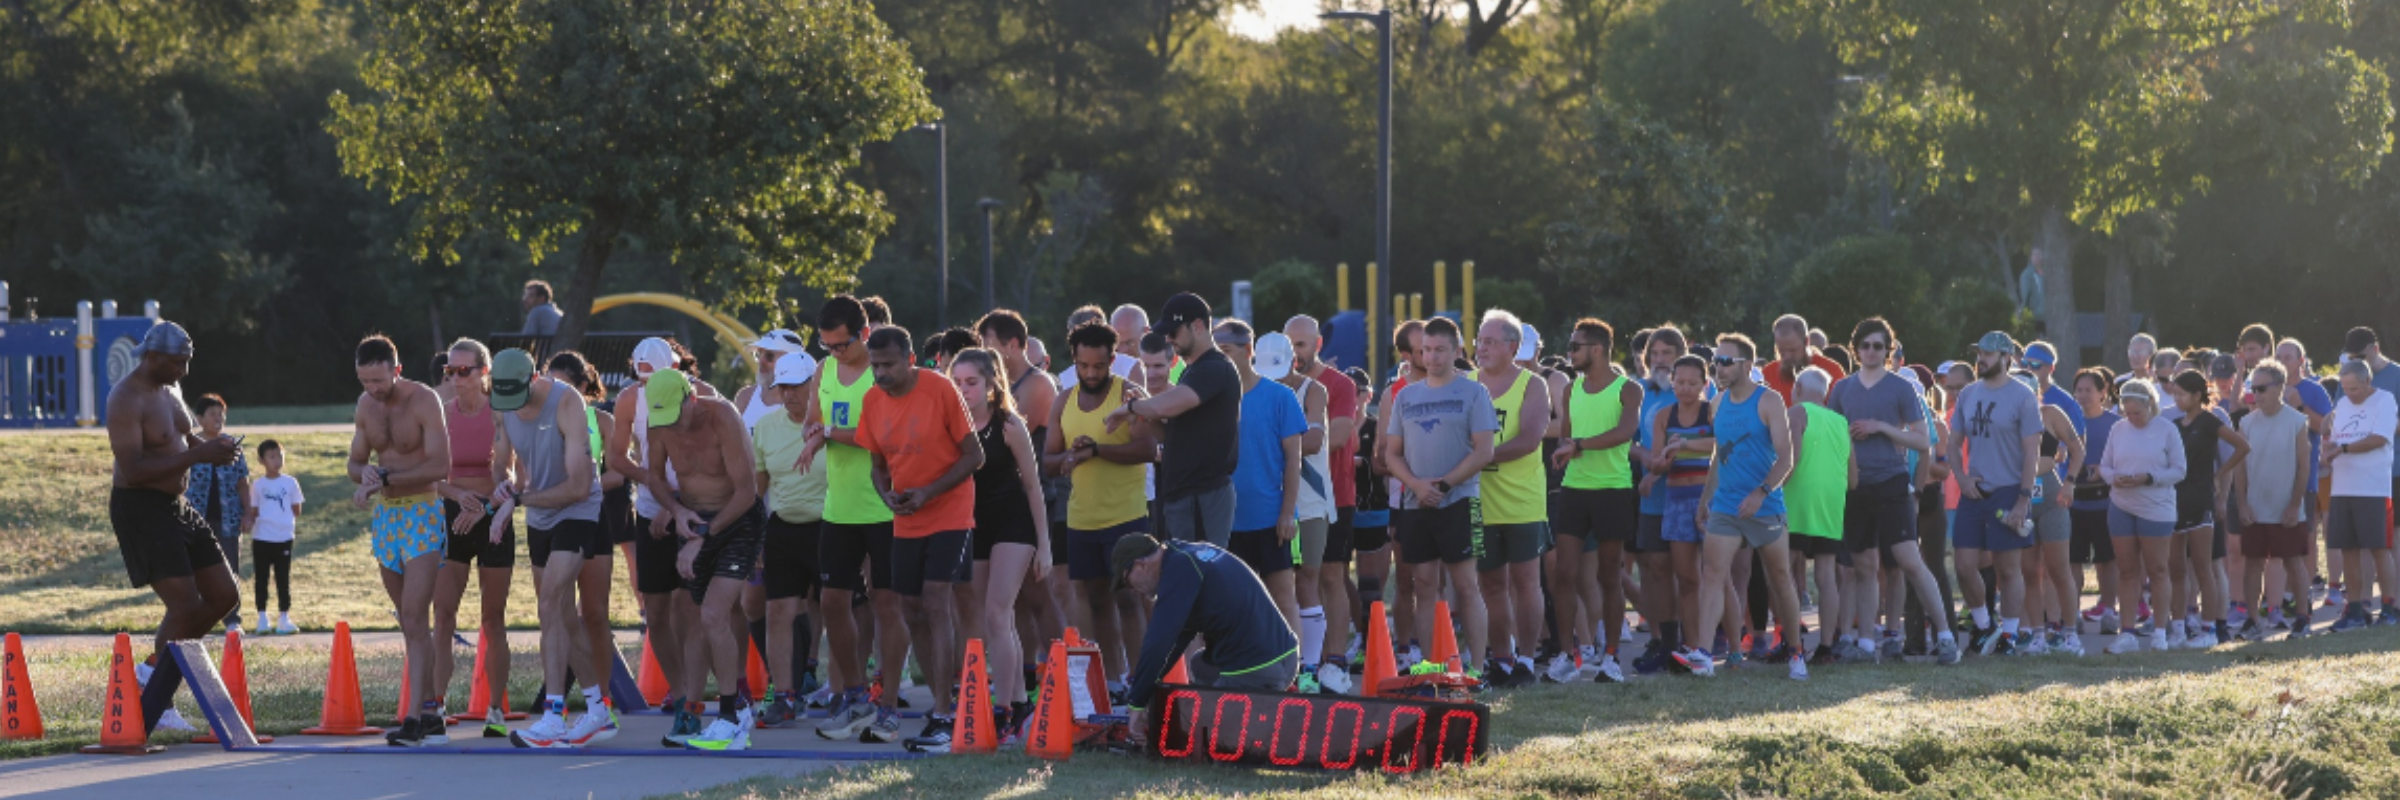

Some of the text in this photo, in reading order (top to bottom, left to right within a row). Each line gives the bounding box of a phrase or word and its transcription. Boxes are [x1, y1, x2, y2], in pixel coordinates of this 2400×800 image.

[5, 652, 19, 730] PLANO
[110, 653, 124, 734] PLANO
[963, 653, 978, 745] PACERS
